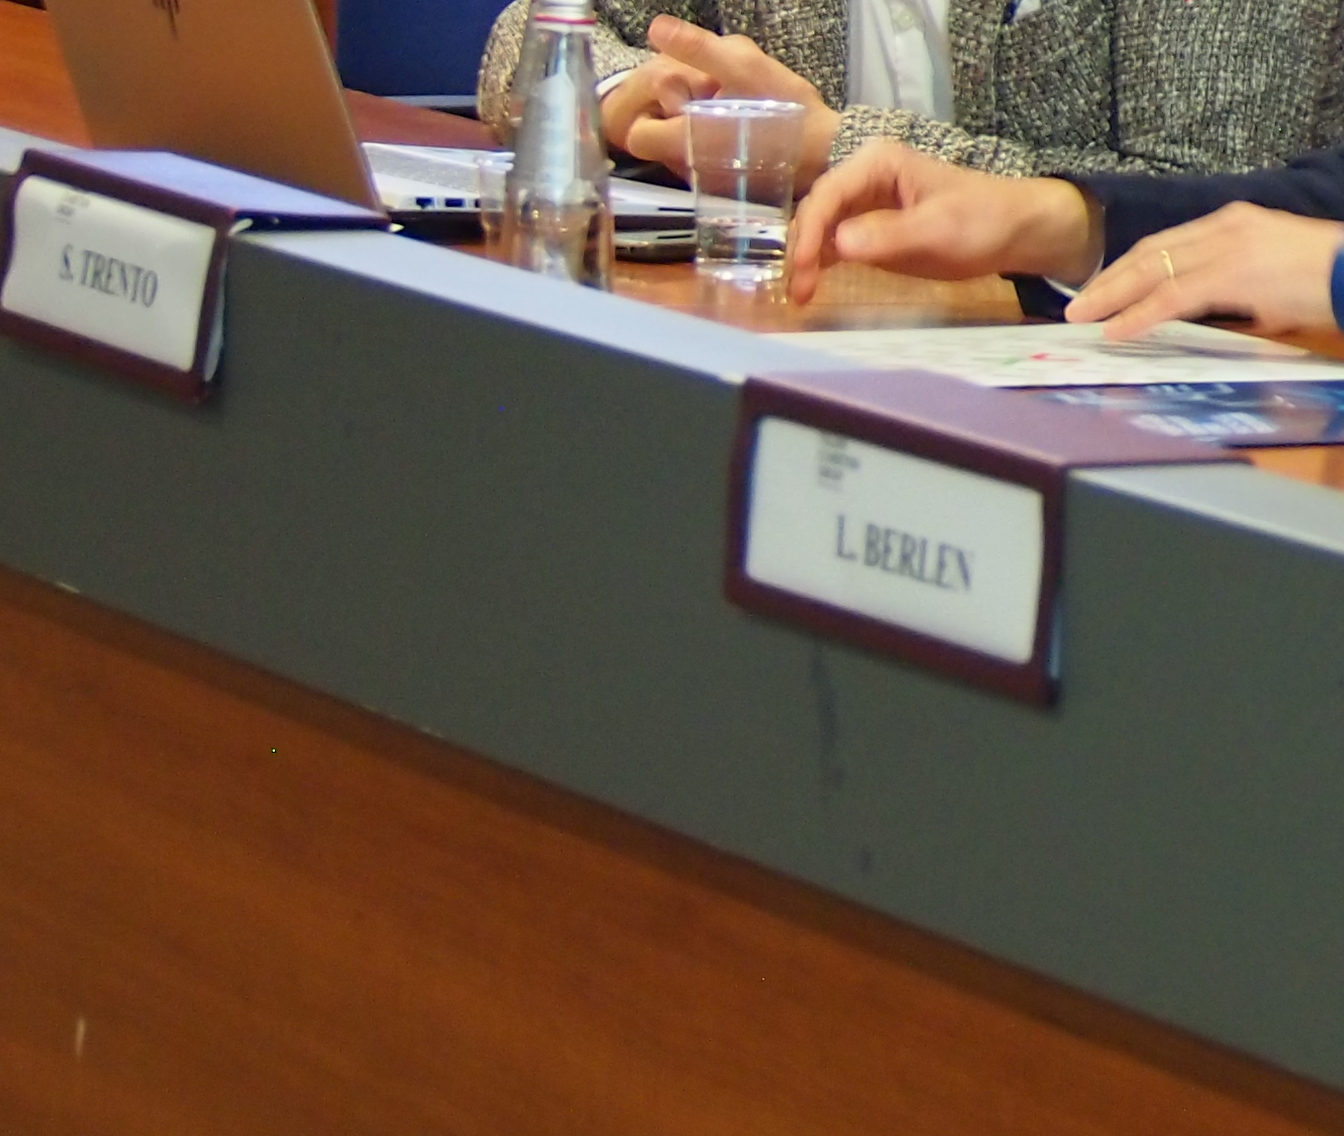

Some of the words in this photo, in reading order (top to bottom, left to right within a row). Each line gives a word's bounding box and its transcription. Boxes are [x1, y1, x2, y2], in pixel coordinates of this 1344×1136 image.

[59, 244, 74, 282] S.
[80, 248, 159, 308] TRENTO
[864, 521, 975, 593] BERLEN
